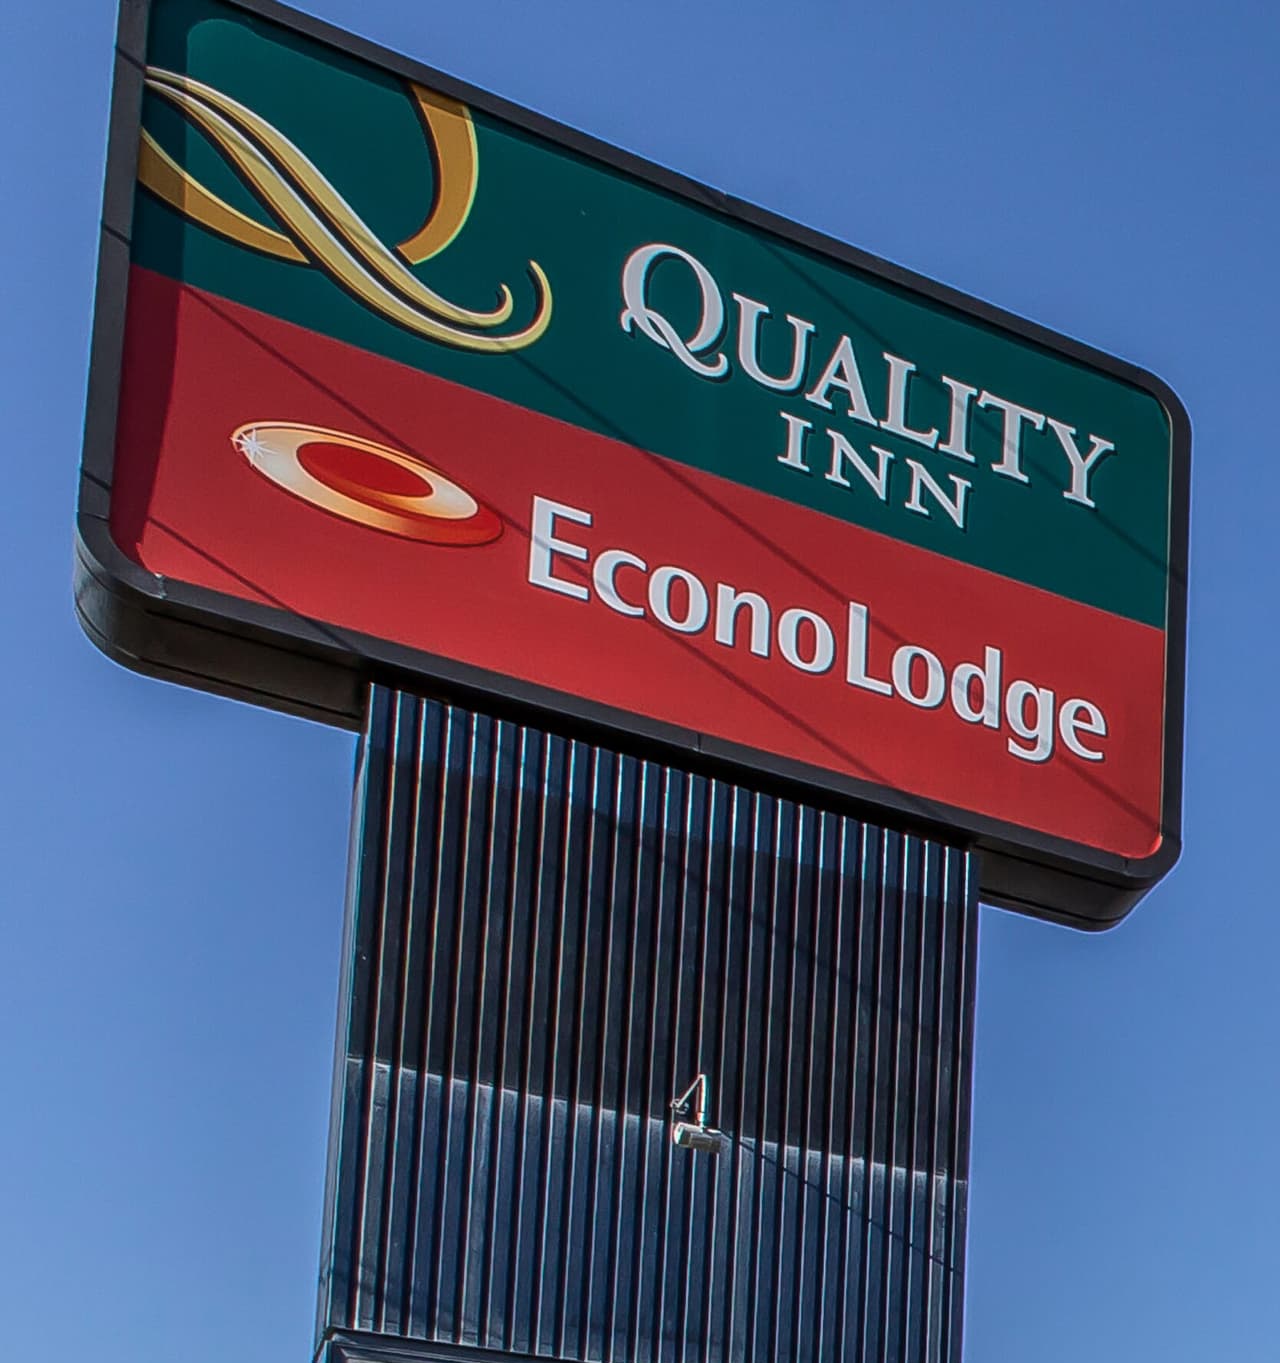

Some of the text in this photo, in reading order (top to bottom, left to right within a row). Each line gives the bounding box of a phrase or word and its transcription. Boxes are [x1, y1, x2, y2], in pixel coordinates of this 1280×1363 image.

[619, 243, 1116, 510] QUALITY
[777, 412, 974, 530] INN
[527, 494, 1109, 764] EconoLodge
